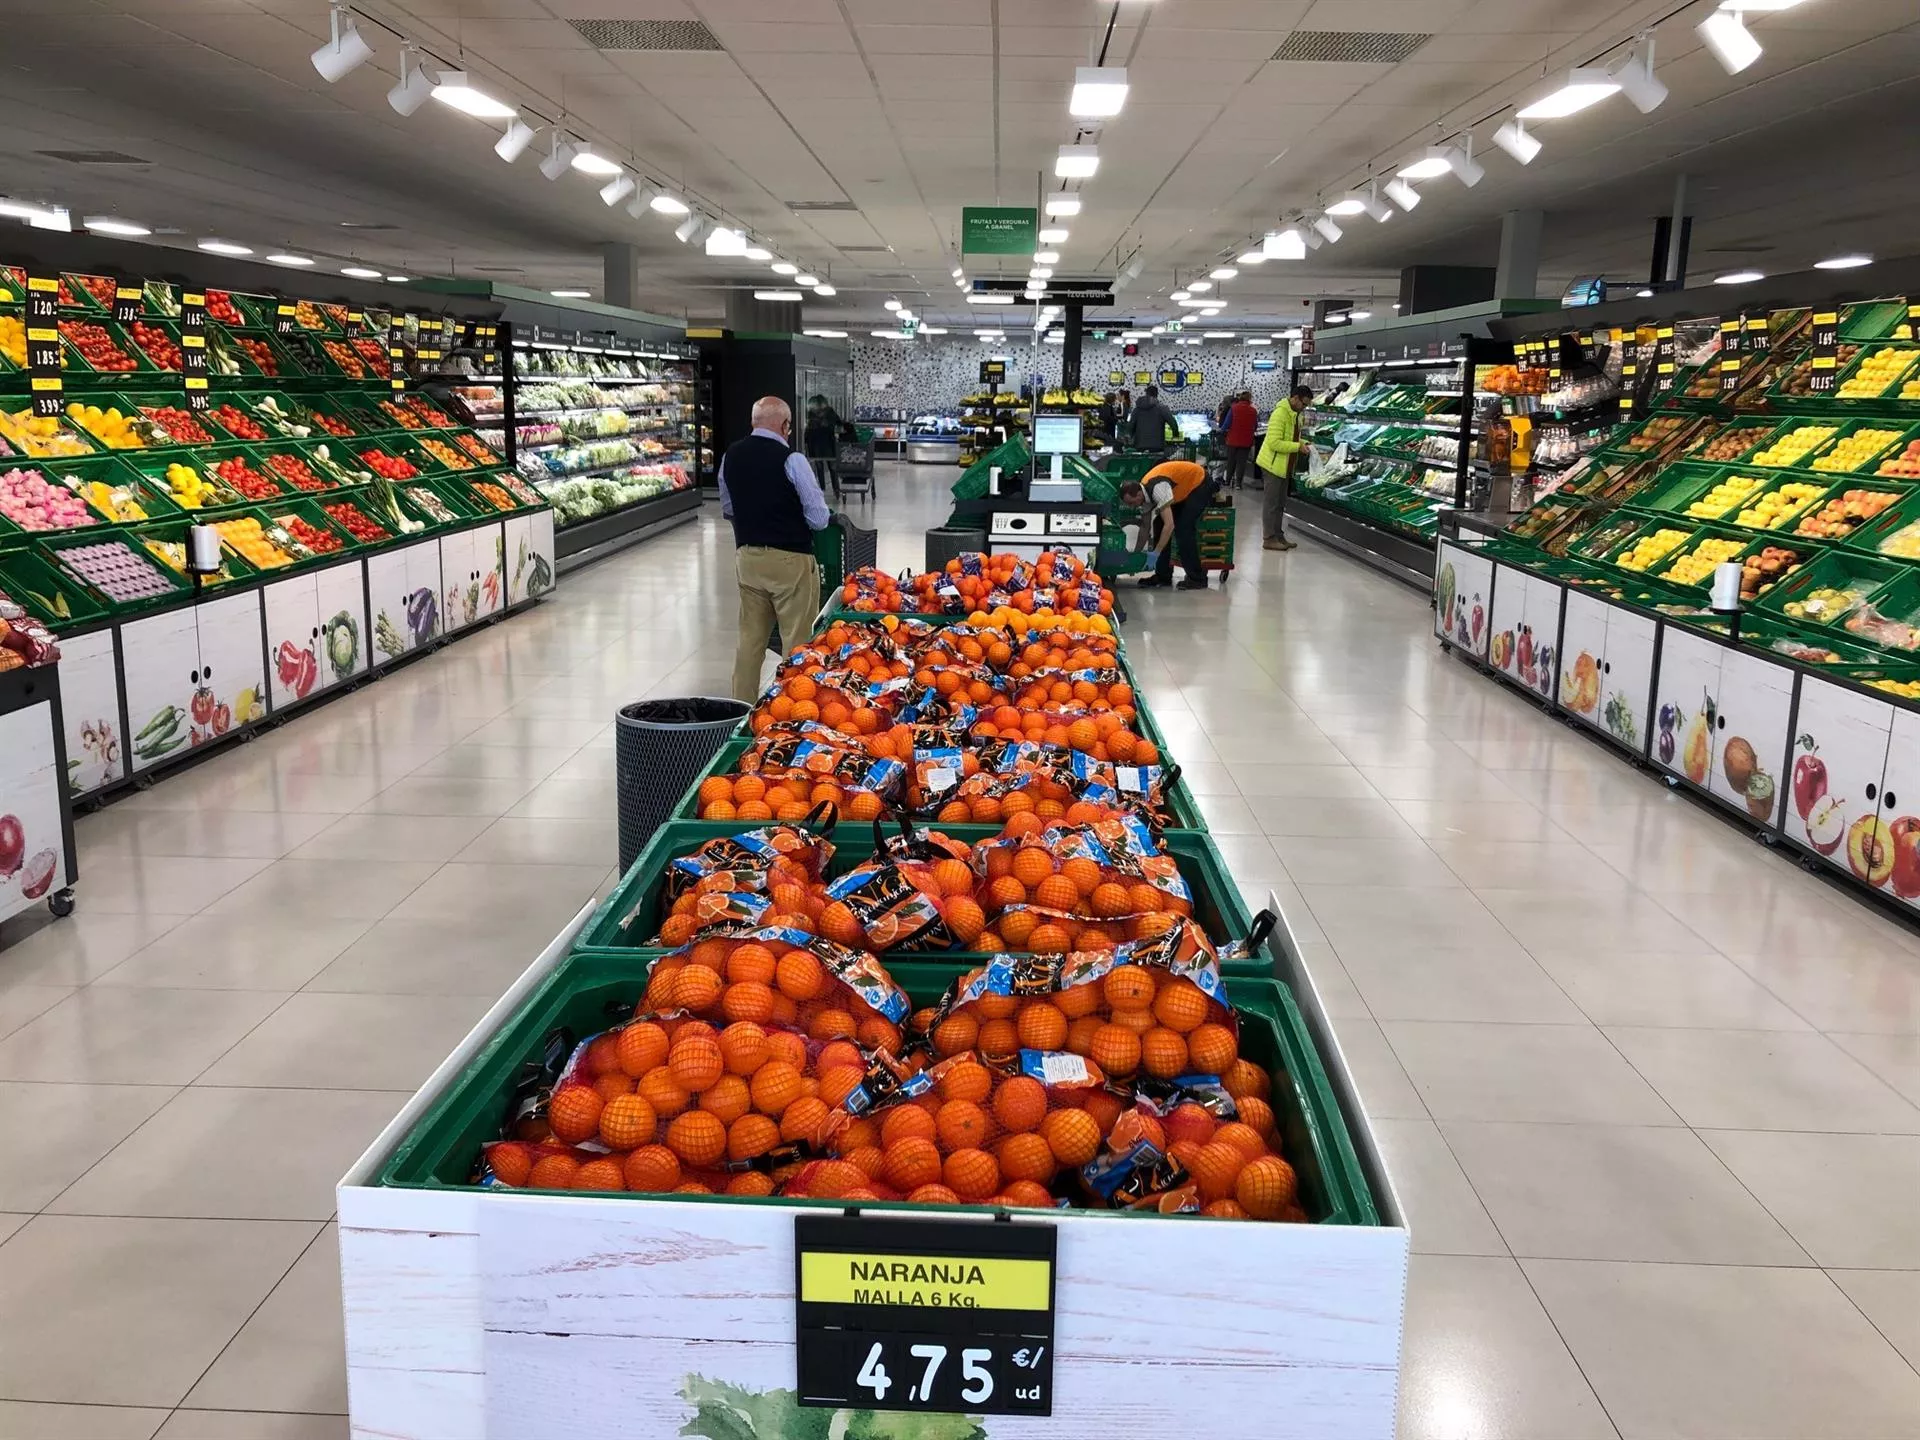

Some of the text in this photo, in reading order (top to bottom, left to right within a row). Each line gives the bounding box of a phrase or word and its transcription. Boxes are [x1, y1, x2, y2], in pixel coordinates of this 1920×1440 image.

[850, 1261, 985, 1285] NARANJA
[853, 1289, 980, 1309] MALLA 6 Kg.
[856, 1341, 994, 1404] 4,75
[1015, 1385, 1041, 1400] ud
